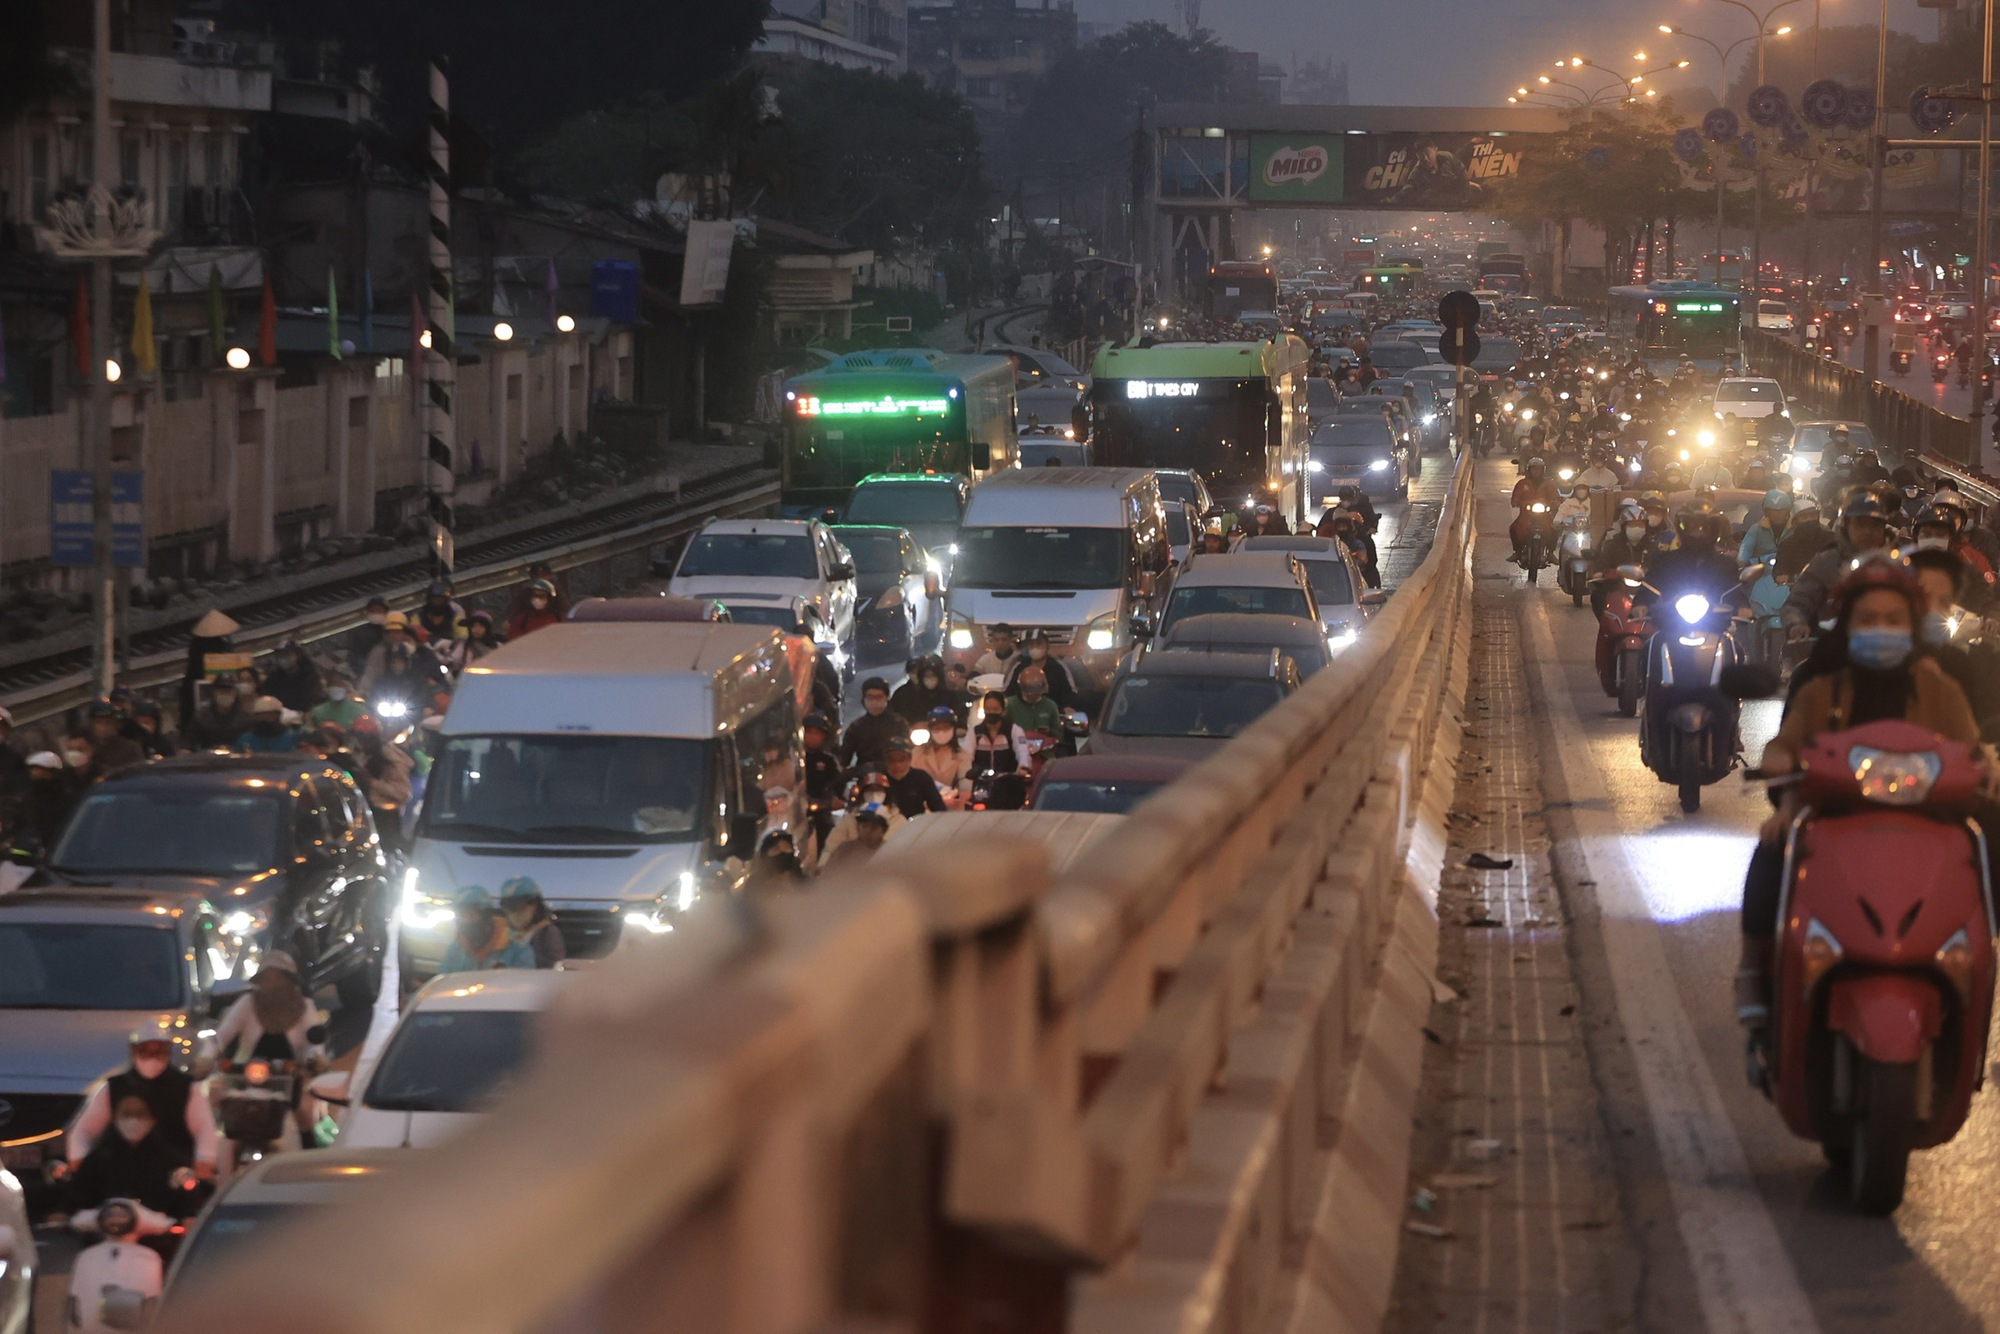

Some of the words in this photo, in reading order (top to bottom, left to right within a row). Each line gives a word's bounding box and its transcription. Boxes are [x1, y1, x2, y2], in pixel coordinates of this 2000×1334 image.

[1472, 139, 1495, 157] THÌ
[1271, 157, 1322, 177] MILO
[1467, 148, 1523, 180] NÊN
[1180, 383, 1200, 397] CITY
